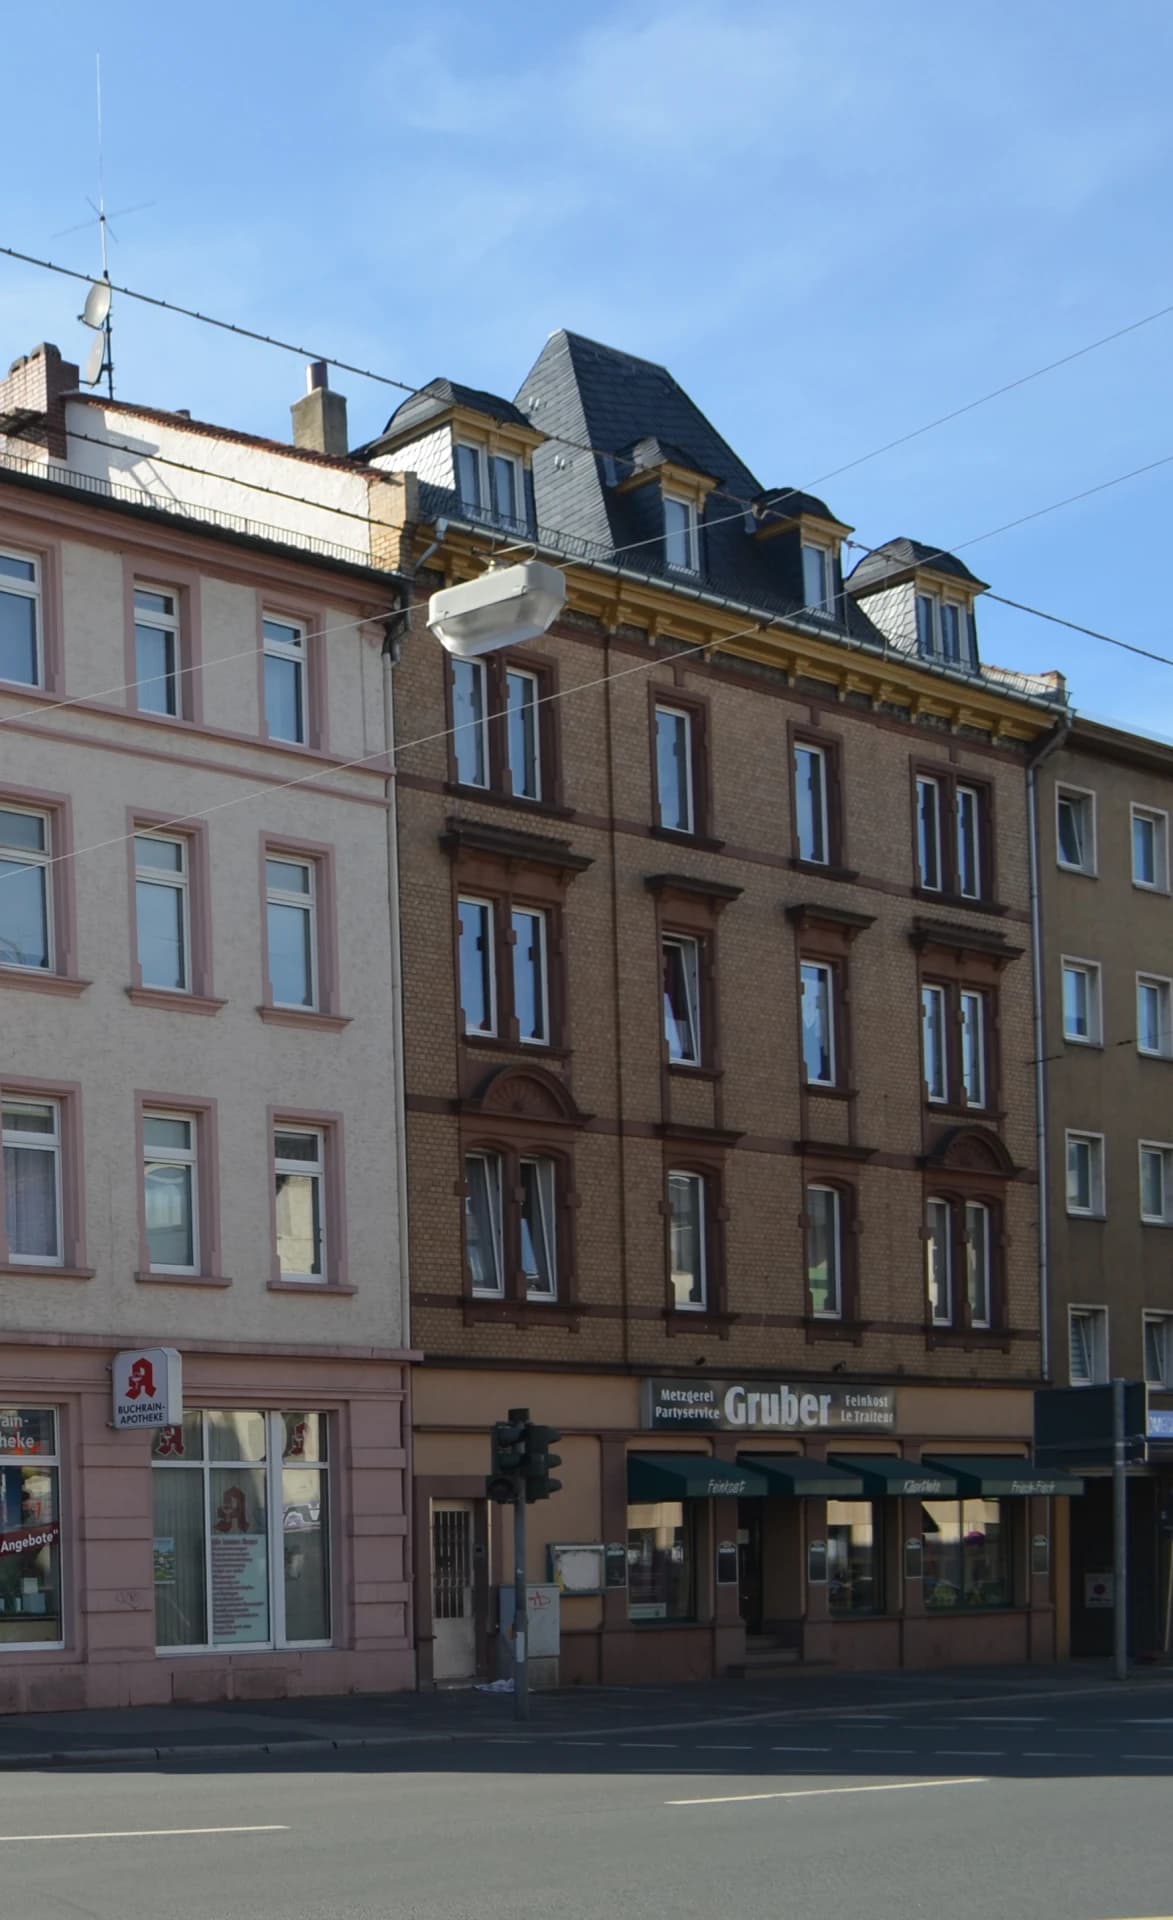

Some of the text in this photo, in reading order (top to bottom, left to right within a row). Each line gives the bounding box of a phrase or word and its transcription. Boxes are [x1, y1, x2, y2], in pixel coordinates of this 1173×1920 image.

[660, 1389, 714, 1404] Metzgerei
[845, 1393, 888, 1408] Feinkost
[118, 1402, 166, 1415] BUCHRAIN-
[655, 1405, 720, 1420] Partyservice
[724, 1385, 831, 1425] Gruber
[120, 1412, 164, 1425] APOTHEKE
[840, 1409, 894, 1424] Le Traiteur
